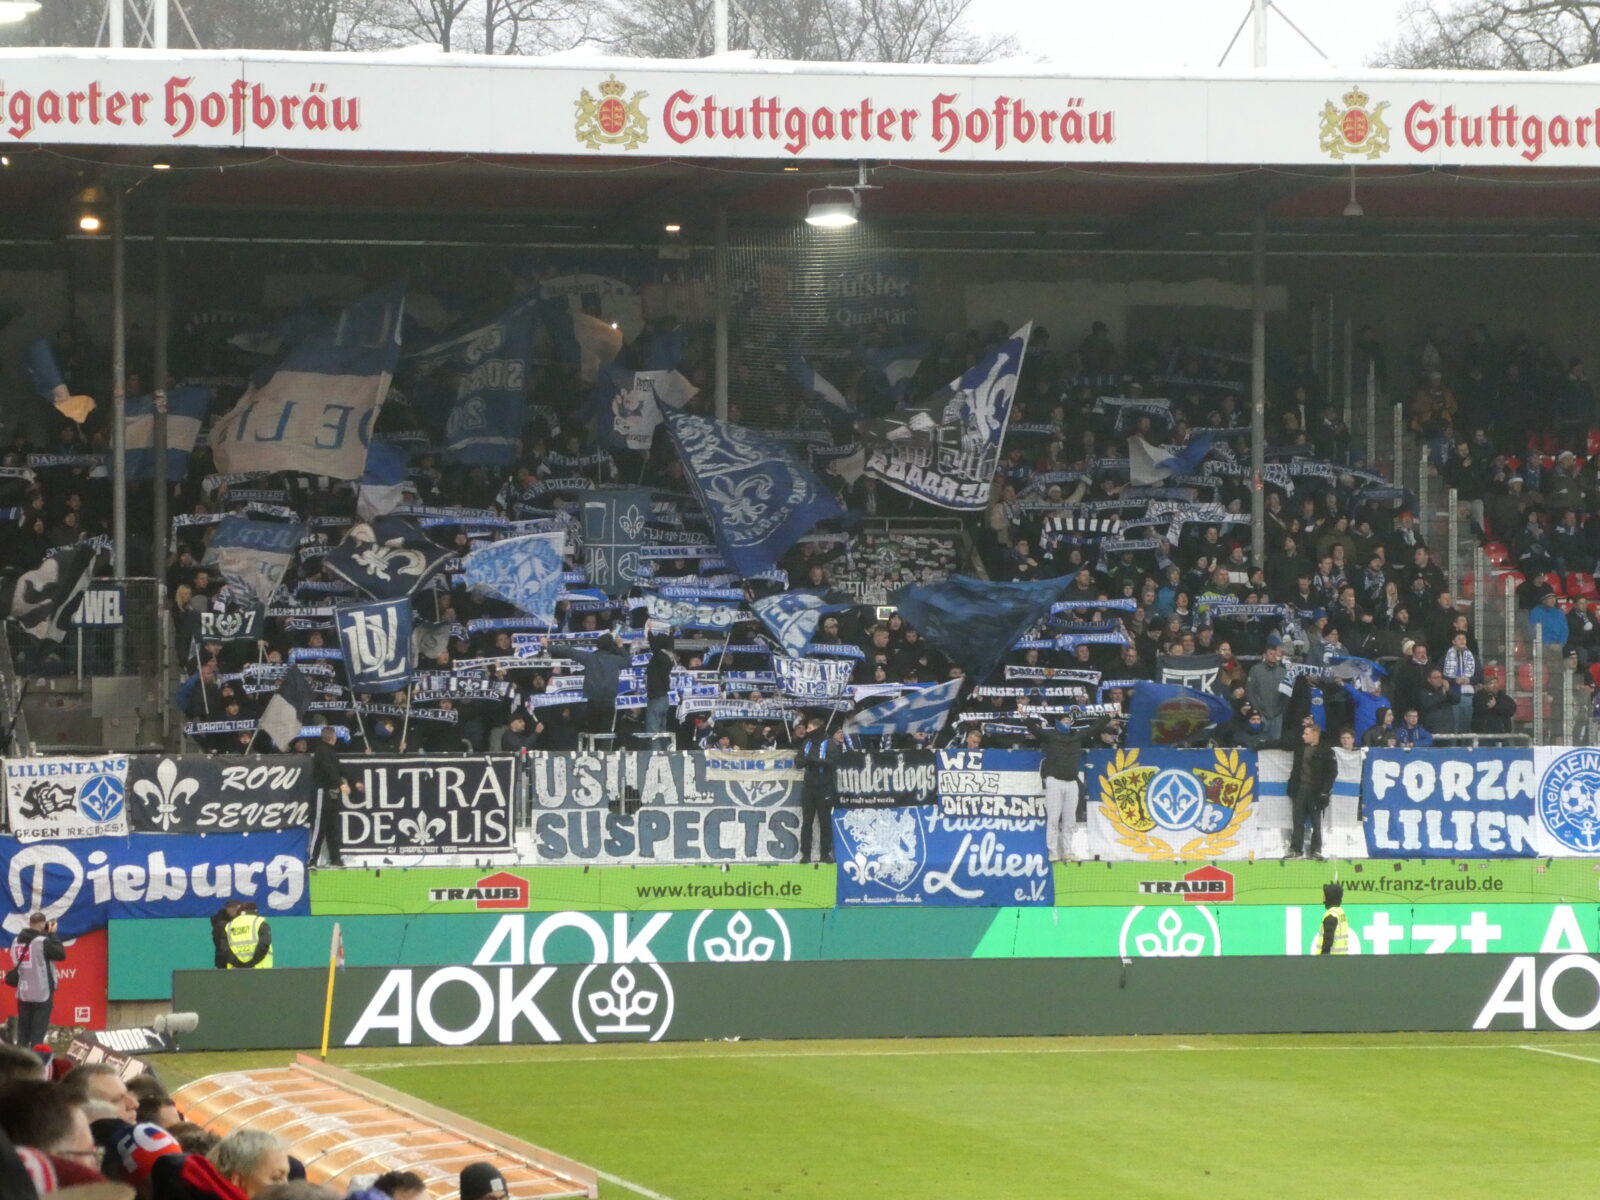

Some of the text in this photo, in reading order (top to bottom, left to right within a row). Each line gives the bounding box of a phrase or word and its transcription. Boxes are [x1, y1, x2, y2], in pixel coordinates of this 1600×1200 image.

[163, 75, 362, 138] Hofbräu
[662, 89, 1117, 155] Stuttgarter Hofbräu
[1219, 606, 1274, 615] DARMSTADT
[7, 758, 127, 779] LILIENFANS
[221, 765, 302, 791] ROW
[534, 751, 715, 809] USUAL
[836, 752, 936, 801] underdogs
[939, 750, 983, 770] WE
[940, 771, 1000, 794] ARE
[1371, 759, 1536, 803] FORZA
[1545, 753, 1600, 830] RheinHEIN
[14, 827, 60, 840] GEGEN
[196, 800, 312, 829] SEVEN
[340, 809, 507, 845] DE LIS
[536, 808, 800, 860] SUSPECTS
[1373, 809, 1539, 853] LILIEN
[923, 831, 1049, 899] Lilien
[2, 844, 305, 935] Dieburg
[430, 888, 519, 901] TRAUB
[636, 881, 802, 898] www.traubdich.de
[1014, 879, 1046, 902] e.V.
[1140, 881, 1225, 893] TRAUB
[471, 911, 673, 966] AOK
[343, 966, 562, 1046] AOK
